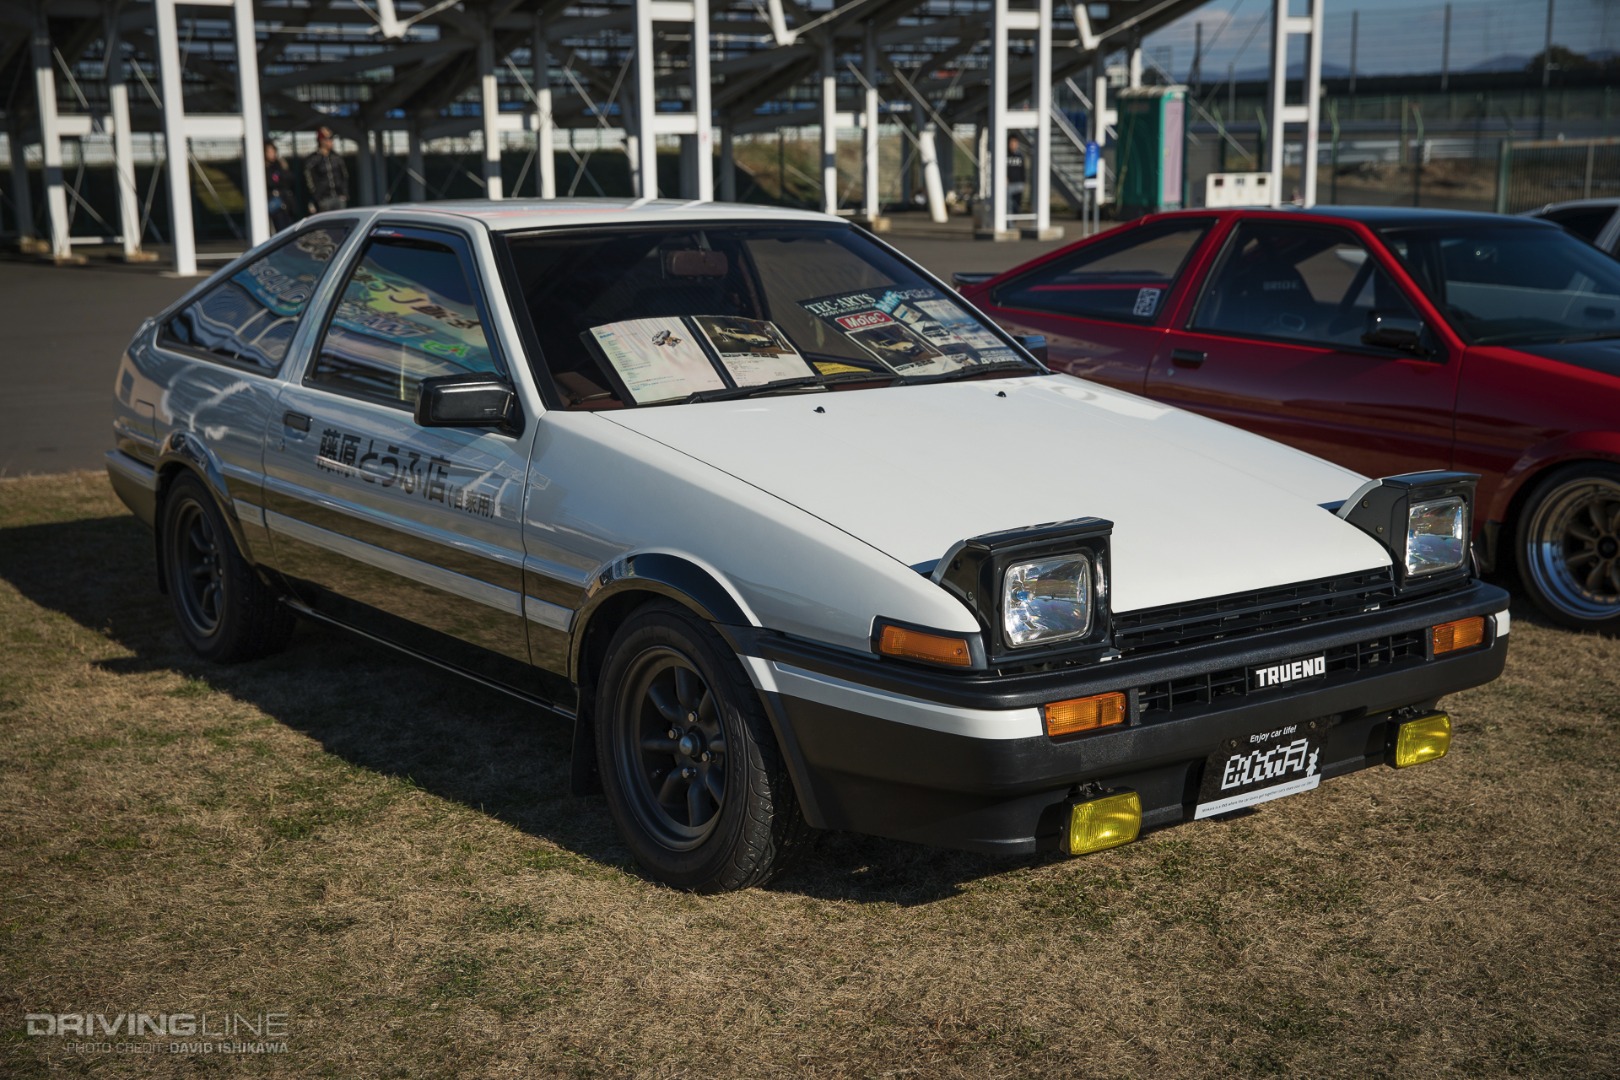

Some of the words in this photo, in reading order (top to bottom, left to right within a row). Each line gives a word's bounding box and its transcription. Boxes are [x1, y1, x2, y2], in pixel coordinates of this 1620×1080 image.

[844, 312, 885, 330] MoTeC
[1255, 656, 1326, 687] TRUENO
[1250, 731, 1270, 744] Enjoy
[1270, 728, 1283, 739] car
